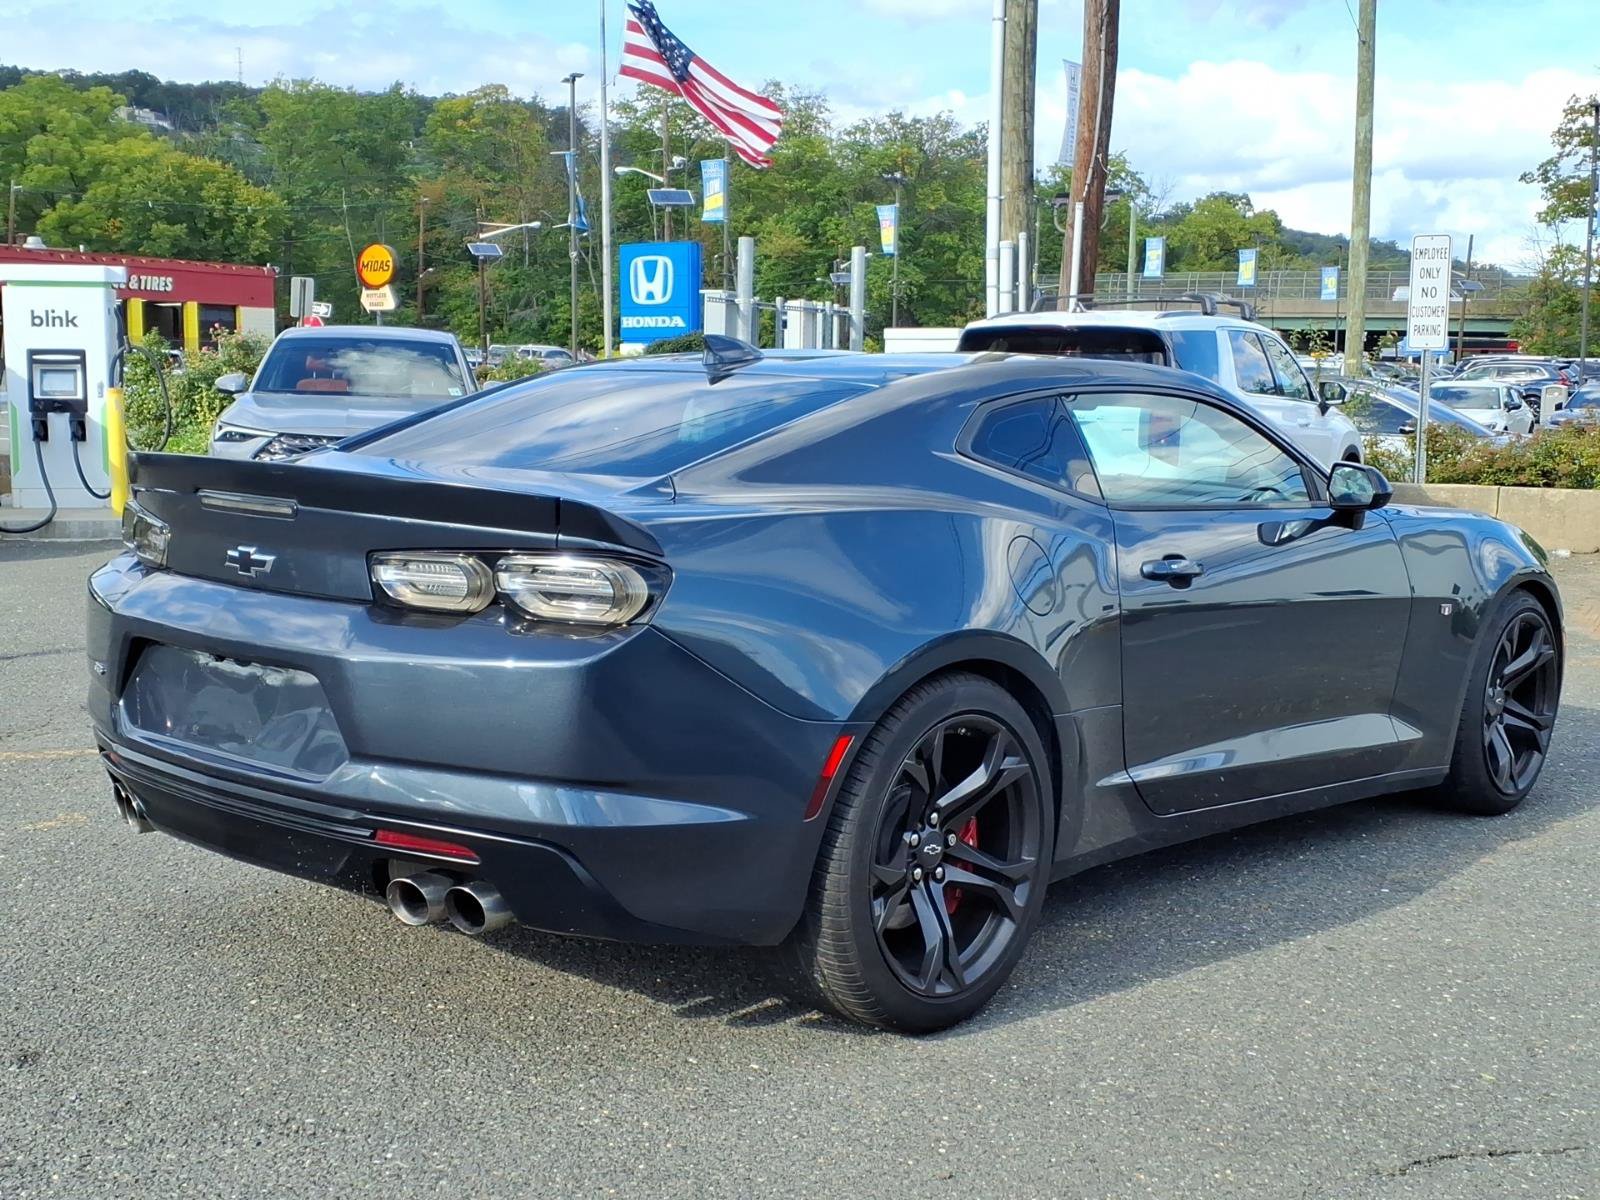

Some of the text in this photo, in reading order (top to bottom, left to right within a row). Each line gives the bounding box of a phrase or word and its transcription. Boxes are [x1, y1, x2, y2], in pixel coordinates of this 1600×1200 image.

[1415, 247, 1448, 260] EMPLOYEE
[361, 260, 391, 272] MIDAS
[1419, 267, 1441, 279] ONLY
[129, 274, 139, 290] &
[139, 275, 173, 292] TIRES
[1421, 286, 1438, 298] NO
[1411, 305, 1446, 318] CUSTOMER
[30, 309, 79, 328] blink
[621, 316, 686, 328] HONDA
[1413, 324, 1441, 337] PARKING
